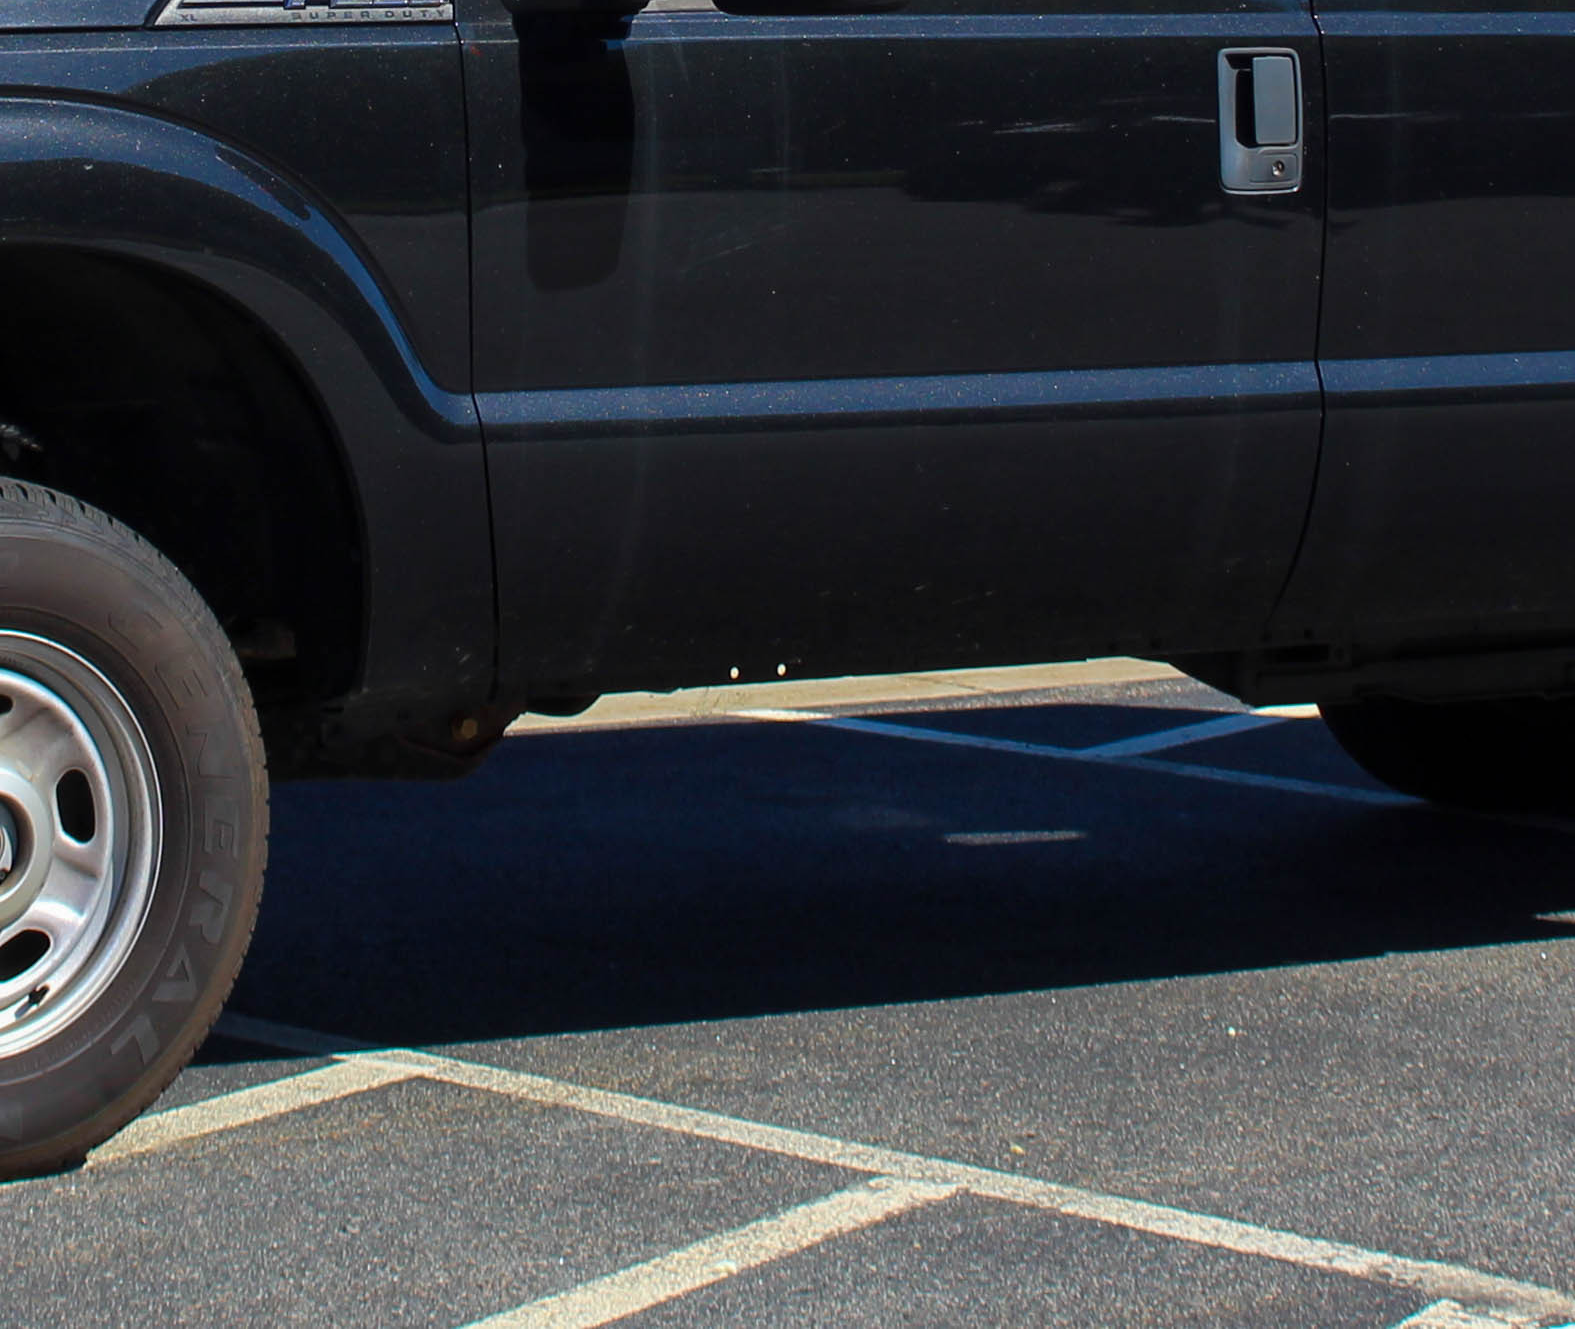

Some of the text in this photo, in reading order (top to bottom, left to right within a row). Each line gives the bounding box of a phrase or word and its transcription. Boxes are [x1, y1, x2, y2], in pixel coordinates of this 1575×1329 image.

[181, 13, 198, 22] XL
[291, 8, 445, 20] SUPER DUTY
